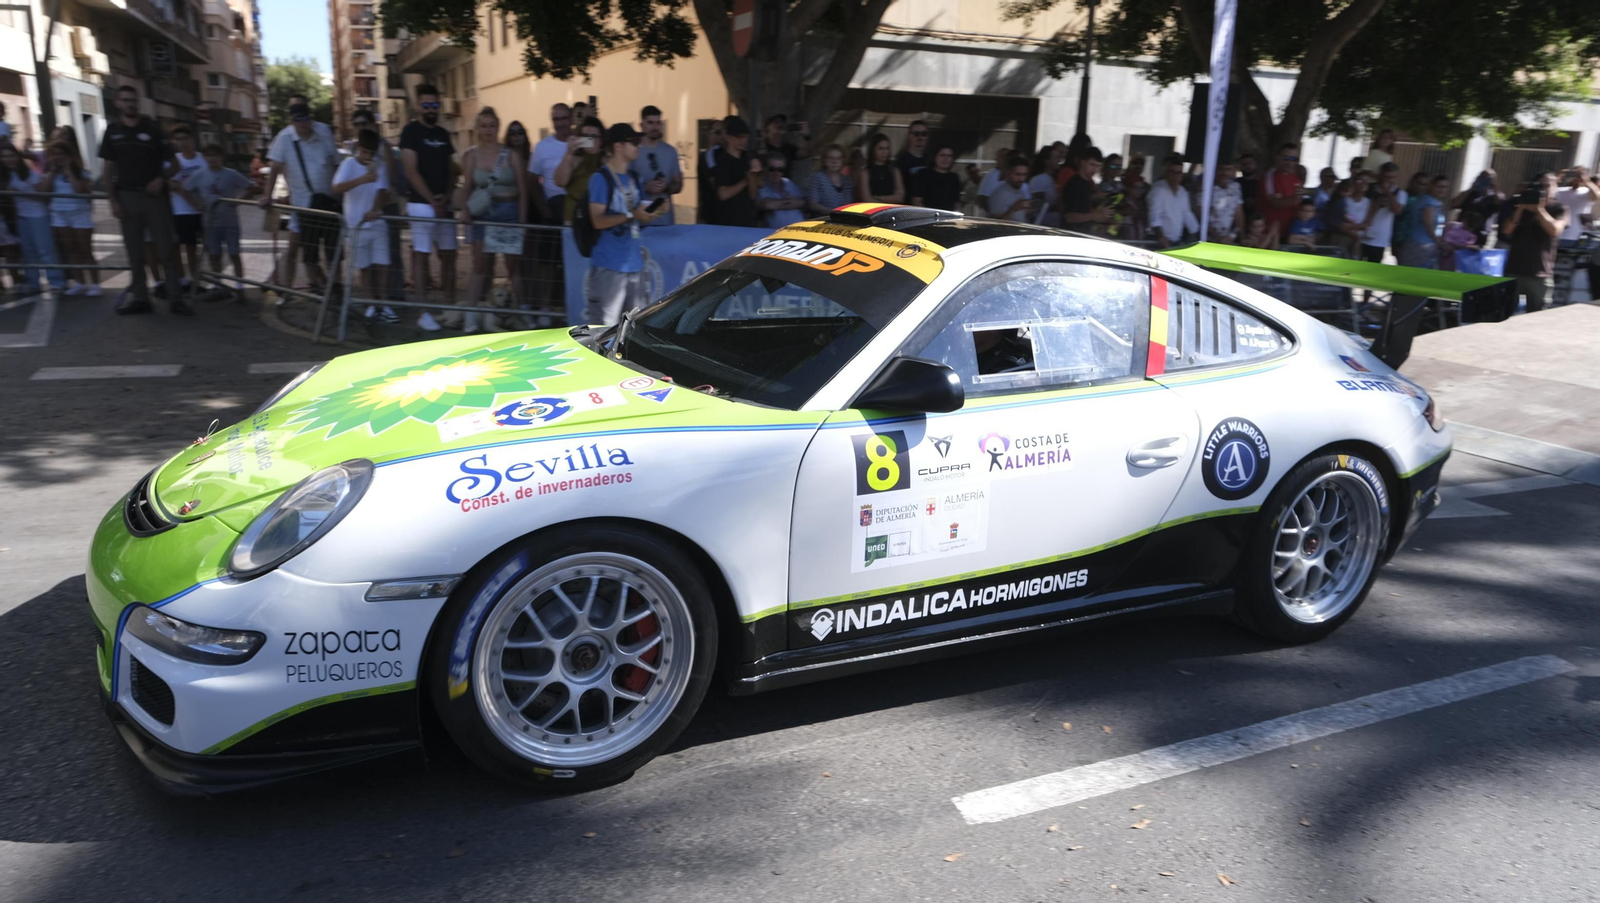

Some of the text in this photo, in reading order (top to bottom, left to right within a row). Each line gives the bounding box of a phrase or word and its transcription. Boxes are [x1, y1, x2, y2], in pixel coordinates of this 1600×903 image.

[588, 392, 604, 405] 8
[1015, 432, 1070, 449] COSTA DE
[1203, 421, 1269, 460] LITTLE WARRIORS
[865, 434, 900, 491] 8
[918, 463, 971, 476] CUPRA
[1004, 445, 1072, 471] ALMERÍA
[1223, 442, 1249, 482] A
[446, 443, 635, 504] Sevilla
[923, 472, 965, 483] INDALO MOTOR
[1356, 460, 1388, 509] MICHELIN
[461, 472, 633, 513] Const. de invernaderos
[944, 489, 985, 504] ALMERÍA
[875, 504, 919, 517] DIPUTACIÓN
[875, 511, 917, 524] DE ALMERÍA
[836, 568, 1089, 634] INDALICA HORMIGONES
[284, 629, 401, 661] zapata
[286, 660, 403, 683] PELUQUEROS
